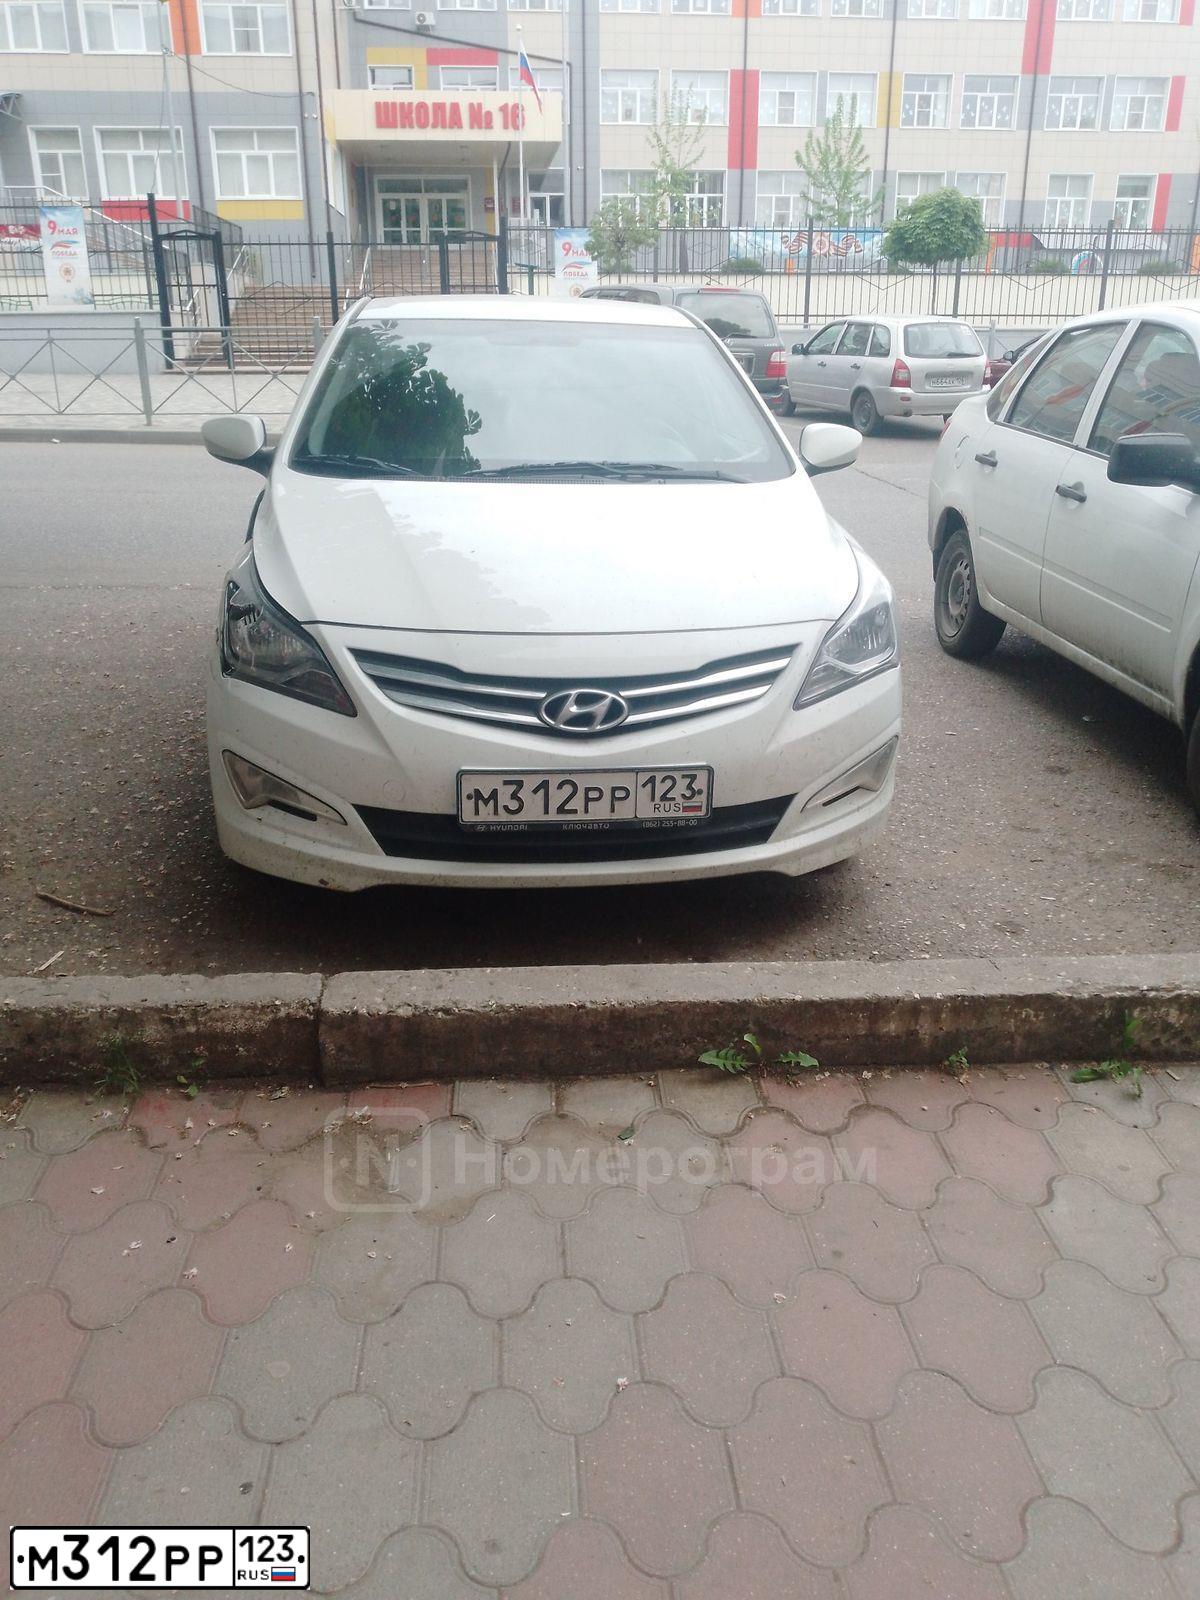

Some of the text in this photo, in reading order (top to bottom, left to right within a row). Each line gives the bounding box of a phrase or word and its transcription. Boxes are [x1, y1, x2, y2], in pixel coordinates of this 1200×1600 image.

[375, 101, 525, 130] ШКОЛА № 16
[47, 220, 57, 235] 9
[562, 242, 572, 256] 9
[473, 774, 698, 816] М312РР 123
[653, 802, 681, 813] RUS
